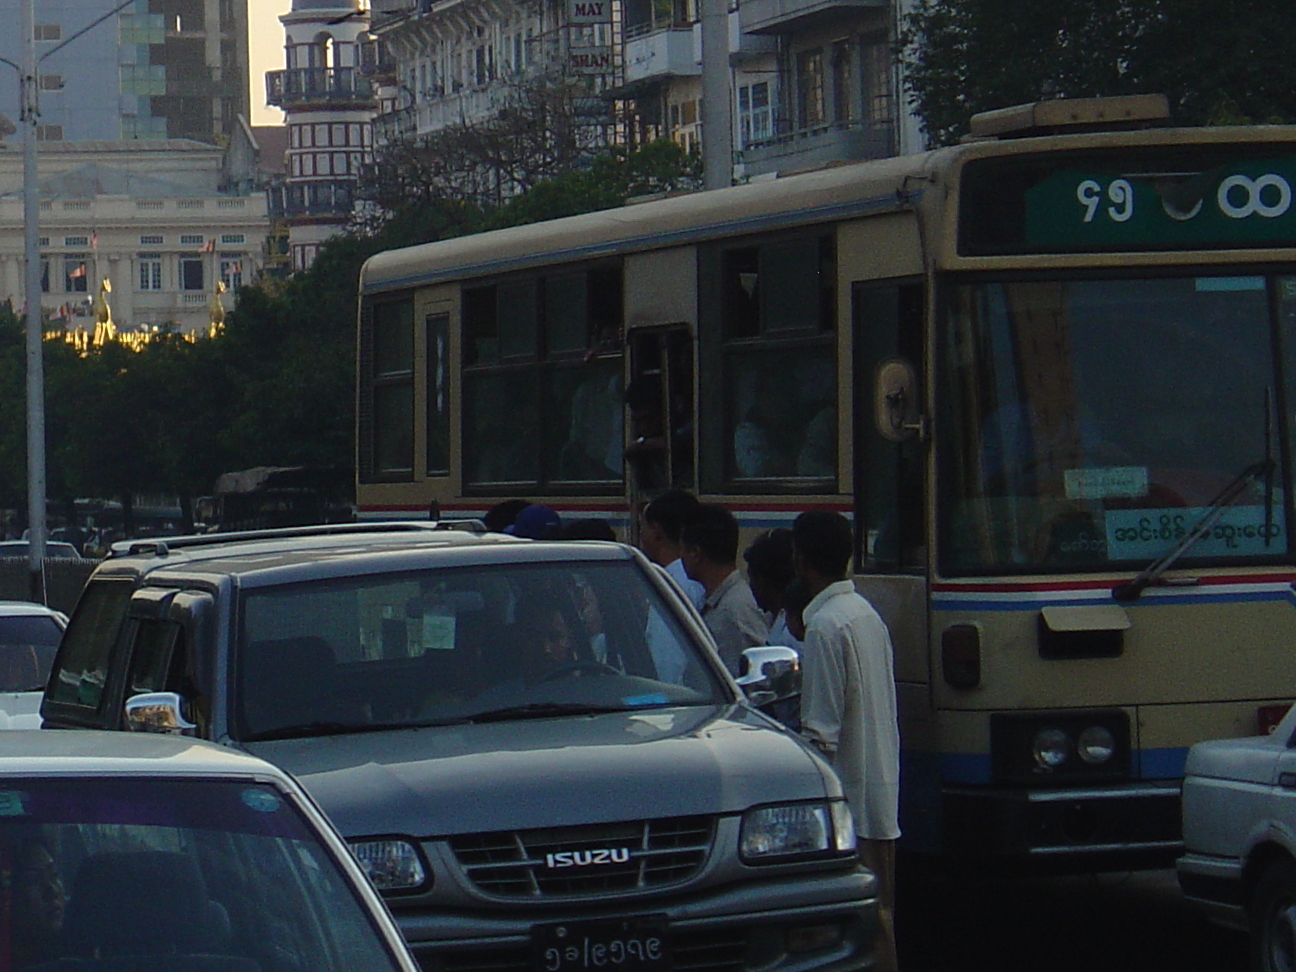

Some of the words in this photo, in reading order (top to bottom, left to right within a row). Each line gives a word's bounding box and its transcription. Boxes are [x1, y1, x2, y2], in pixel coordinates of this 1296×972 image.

[575, 2, 605, 18] MAY
[571, 53, 610, 68] SHAN
[545, 846, 630, 869] ISUZU
